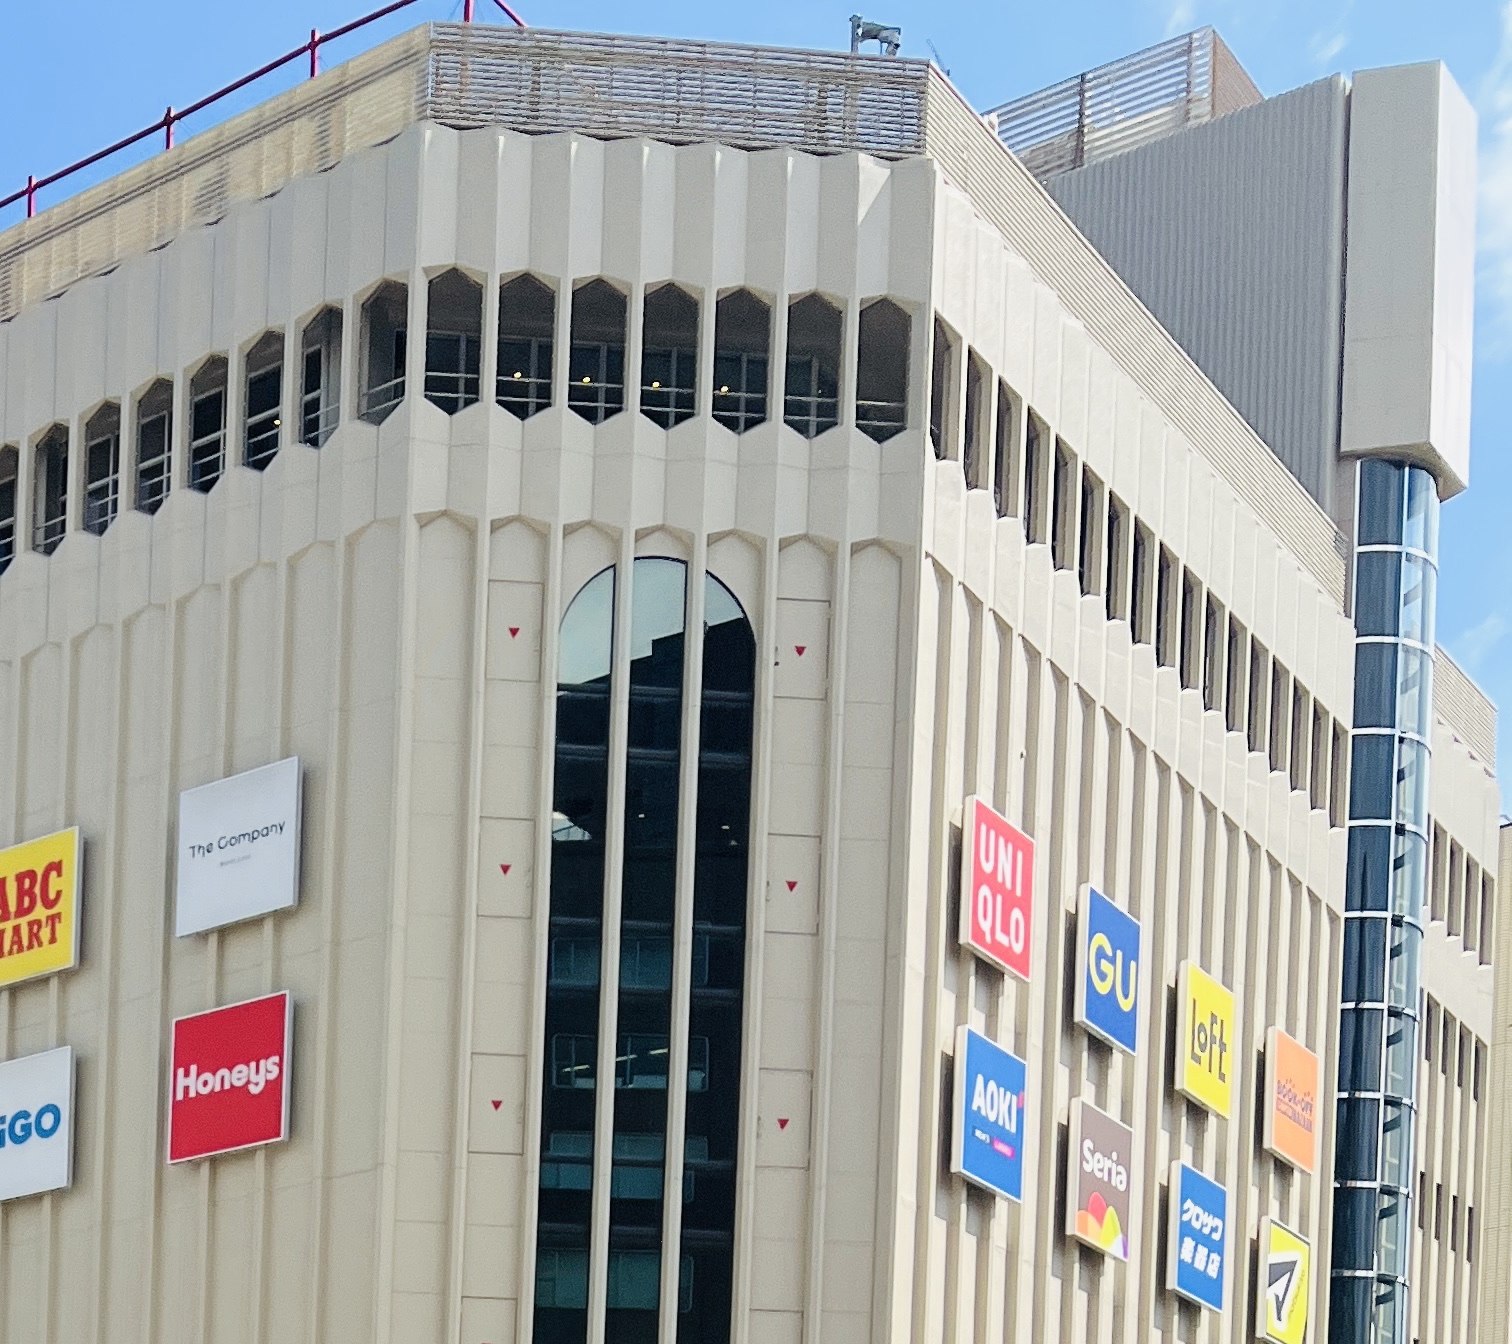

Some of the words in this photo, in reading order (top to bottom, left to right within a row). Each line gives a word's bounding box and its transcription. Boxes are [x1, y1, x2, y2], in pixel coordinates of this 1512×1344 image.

[188, 842, 214, 859] The
[217, 820, 286, 850] Company
[979, 823, 1023, 898] UNI
[977, 885, 1026, 956] QLO
[1088, 932, 1138, 1013] GU
[176, 1054, 280, 1101] Honeys
[971, 1073, 1018, 1134] AOKI
[1082, 1139, 1128, 1192] Seria
[1181, 1198, 1224, 1242] クロサワ
